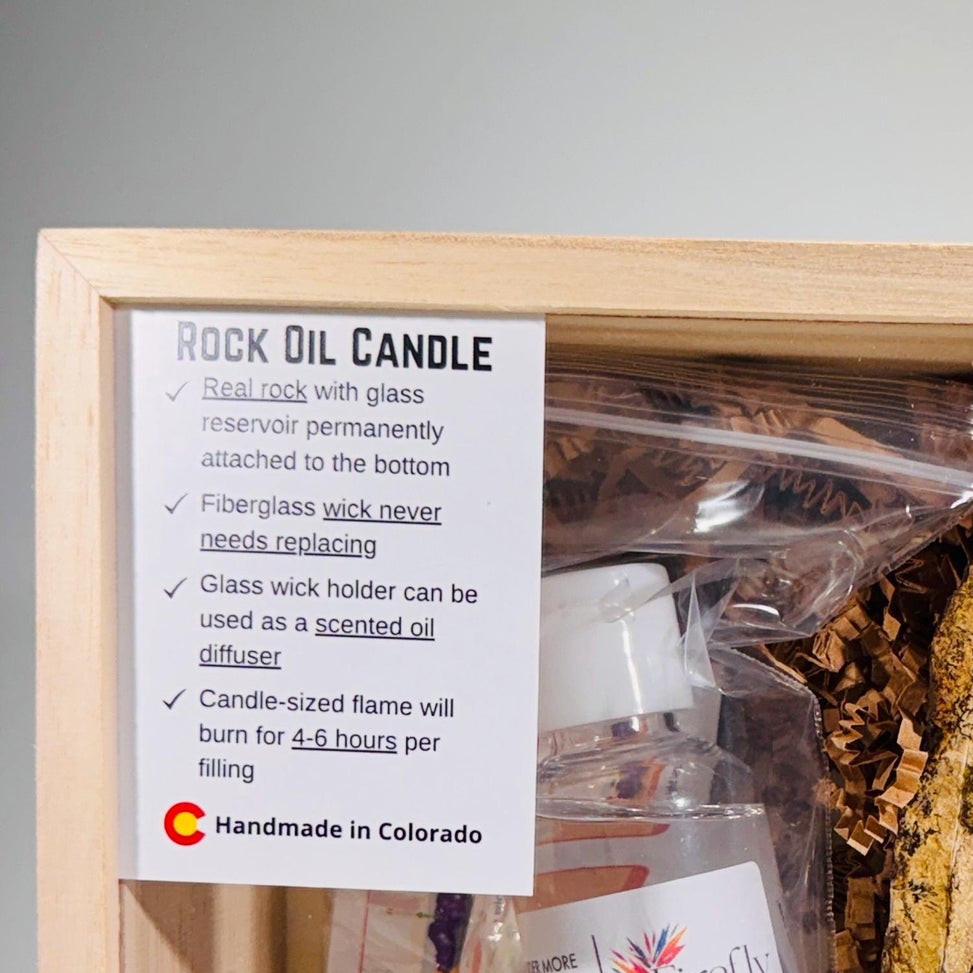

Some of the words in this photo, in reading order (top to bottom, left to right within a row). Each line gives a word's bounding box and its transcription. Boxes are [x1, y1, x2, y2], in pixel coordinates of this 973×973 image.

[176, 320, 270, 364] ROCK
[284, 325, 336, 366] OIL
[352, 327, 493, 372] CANDLE
[202, 377, 252, 400] Real
[261, 382, 308, 402] rock
[314, 381, 359, 402] with
[367, 384, 425, 406] glass
[201, 416, 299, 435] reservoir
[306, 419, 444, 445] permanently
[201, 450, 296, 471] attached
[304, 453, 324, 472] to
[332, 454, 366, 473] the
[374, 455, 450, 476] bottom
[201, 494, 315, 519] Fiberglass
[323, 499, 371, 521] wick
[379, 502, 442, 523] never
[200, 529, 268, 552] needs
[276, 533, 377, 559] replacing
[200, 575, 263, 595] Glass
[271, 578, 320, 597] wick
[327, 579, 396, 600] holder
[403, 584, 443, 602] can
[452, 584, 478, 604] be
[200, 611, 253, 630] used
[261, 615, 287, 631] as
[295, 616, 308, 632] a
[315, 617, 402, 638] scented
[410, 619, 435, 640] oil
[200, 645, 281, 668] diffuser
[199, 689, 344, 713] Candle-sized
[353, 695, 412, 716] flame
[420, 698, 454, 718] will
[199, 724, 247, 744] burn
[256, 726, 285, 745] for
[292, 728, 327, 749] 4-6
[335, 729, 397, 752] hours
[405, 734, 441, 755] per
[199, 758, 255, 783] filling
[216, 817, 342, 838] Handmade
[351, 821, 371, 840] in
[379, 823, 482, 843] Colorado
[542, 953, 578, 972] MORE
